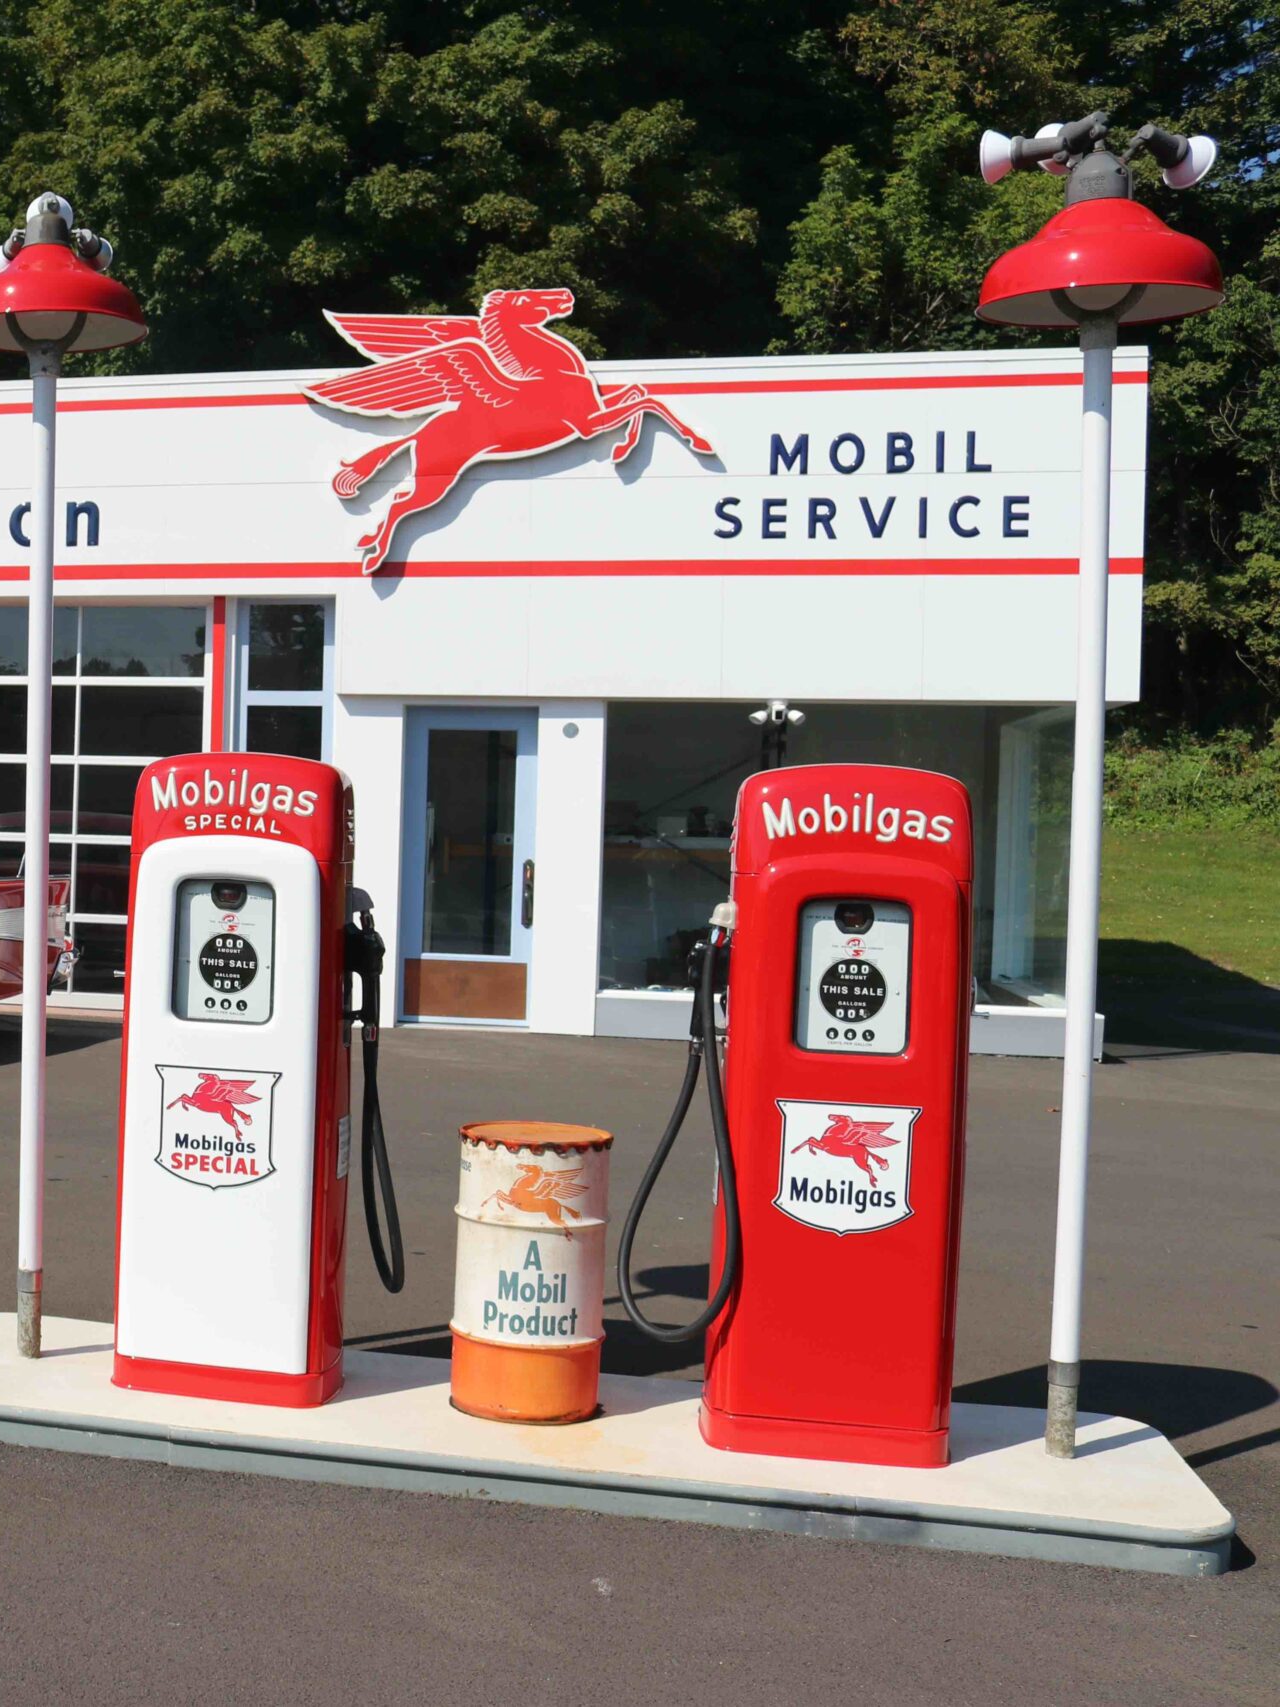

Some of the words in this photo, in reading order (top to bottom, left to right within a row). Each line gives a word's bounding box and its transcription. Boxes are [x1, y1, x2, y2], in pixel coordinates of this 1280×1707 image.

[770, 431, 992, 475] MOBIL
[713, 495, 1030, 539] SERVICE
[151, 768, 319, 817] Mobilgas
[184, 814, 282, 835] SPECIAL
[762, 793, 954, 842] Mobilgas
[201, 957, 224, 967] THIS
[229, 959, 256, 969] SALE
[822, 985, 848, 994] THIS
[854, 987, 884, 996] SALE
[175, 1133, 256, 1156] Mobilgas
[171, 1152, 259, 1176] SPECIAL
[790, 1177, 896, 1214] Mobilgas
[523, 1240, 542, 1271] A
[498, 1270, 567, 1304] Mobil
[483, 1300, 577, 1336] Product
